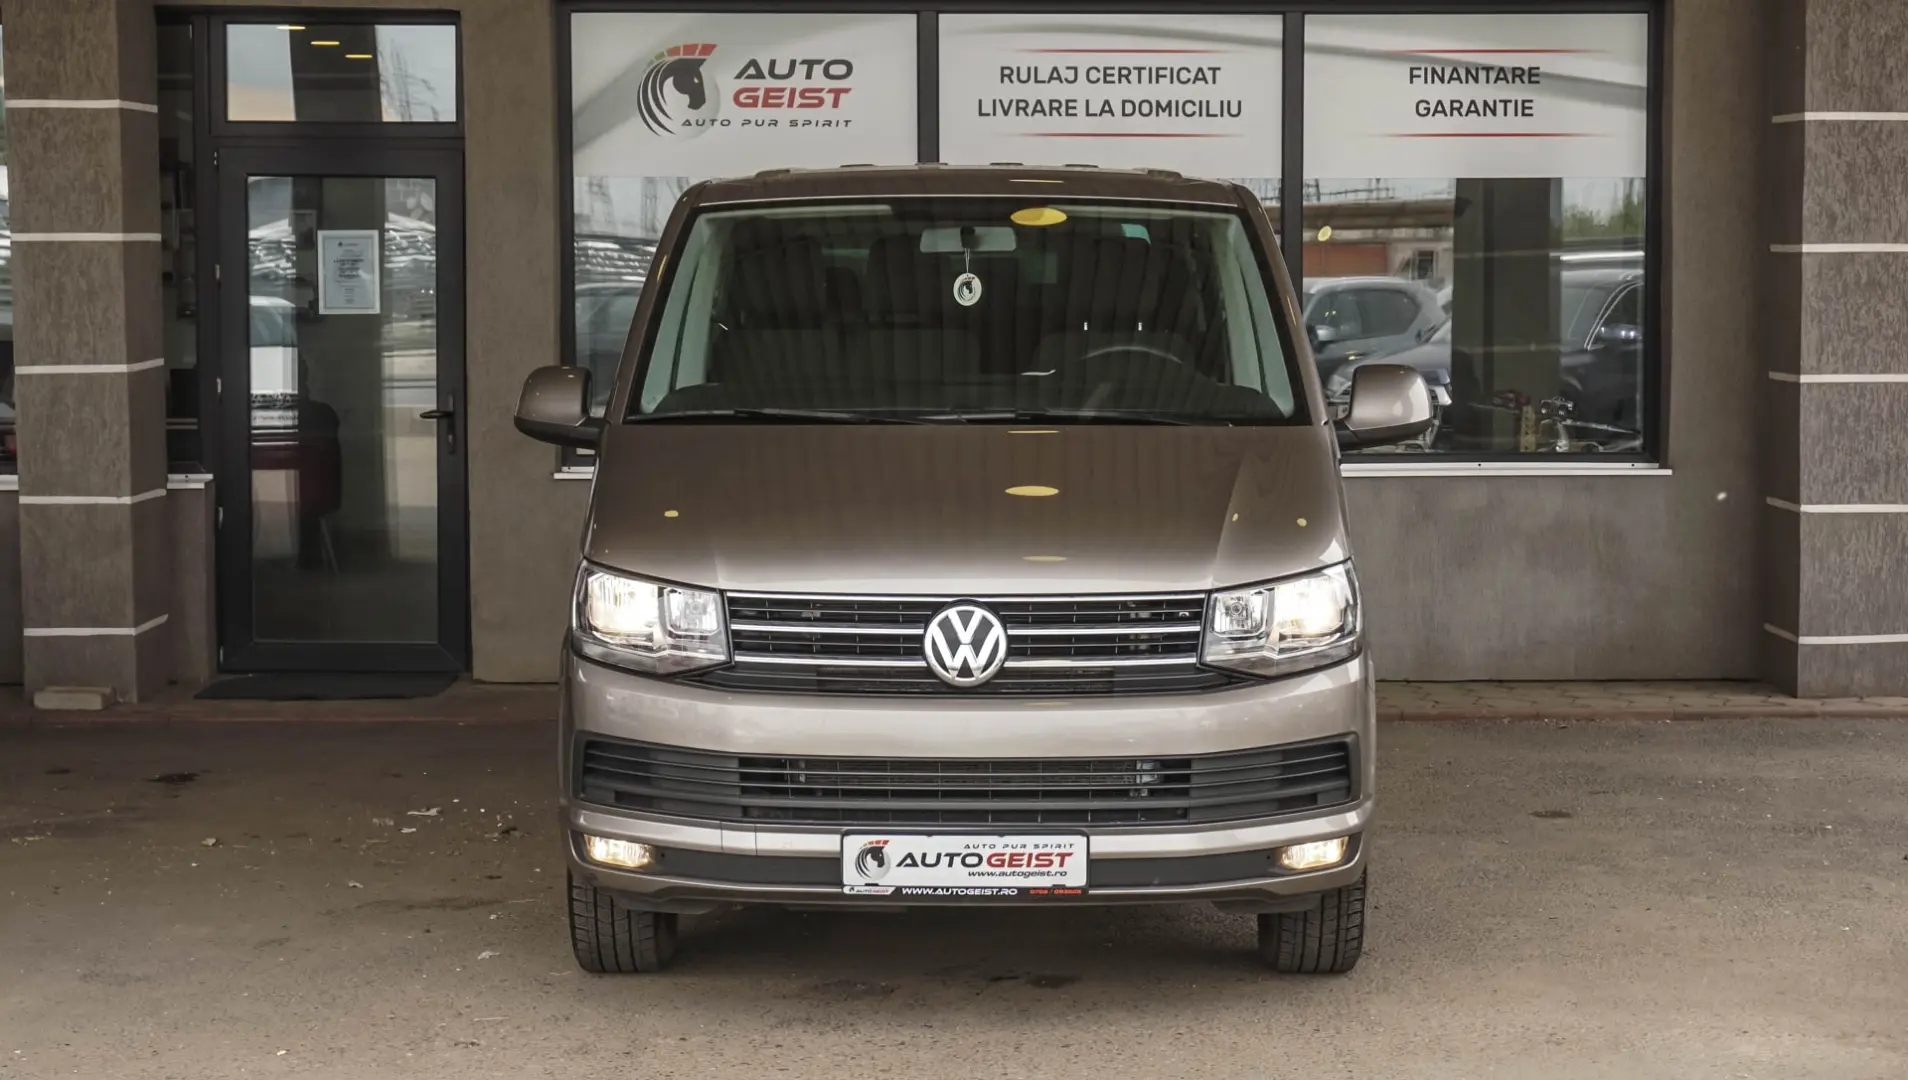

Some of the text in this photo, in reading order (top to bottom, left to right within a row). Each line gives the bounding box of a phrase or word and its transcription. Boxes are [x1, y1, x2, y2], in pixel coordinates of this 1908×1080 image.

[734, 59, 854, 80] AUTO
[1000, 66, 1221, 85] RULAJ CERTIFICAT
[1409, 66, 1541, 84] FINANTARE
[733, 87, 852, 109] GEIST
[977, 99, 1242, 118] LIVRARE LA DOMICILIU
[1415, 99, 1534, 117] GARANTIE
[681, 118, 853, 128] AUTO PUR SPIRIT
[968, 869, 1068, 878] www.autogeist.ro
[902, 887, 1018, 896] WWW.AUTOGEIST.RO
